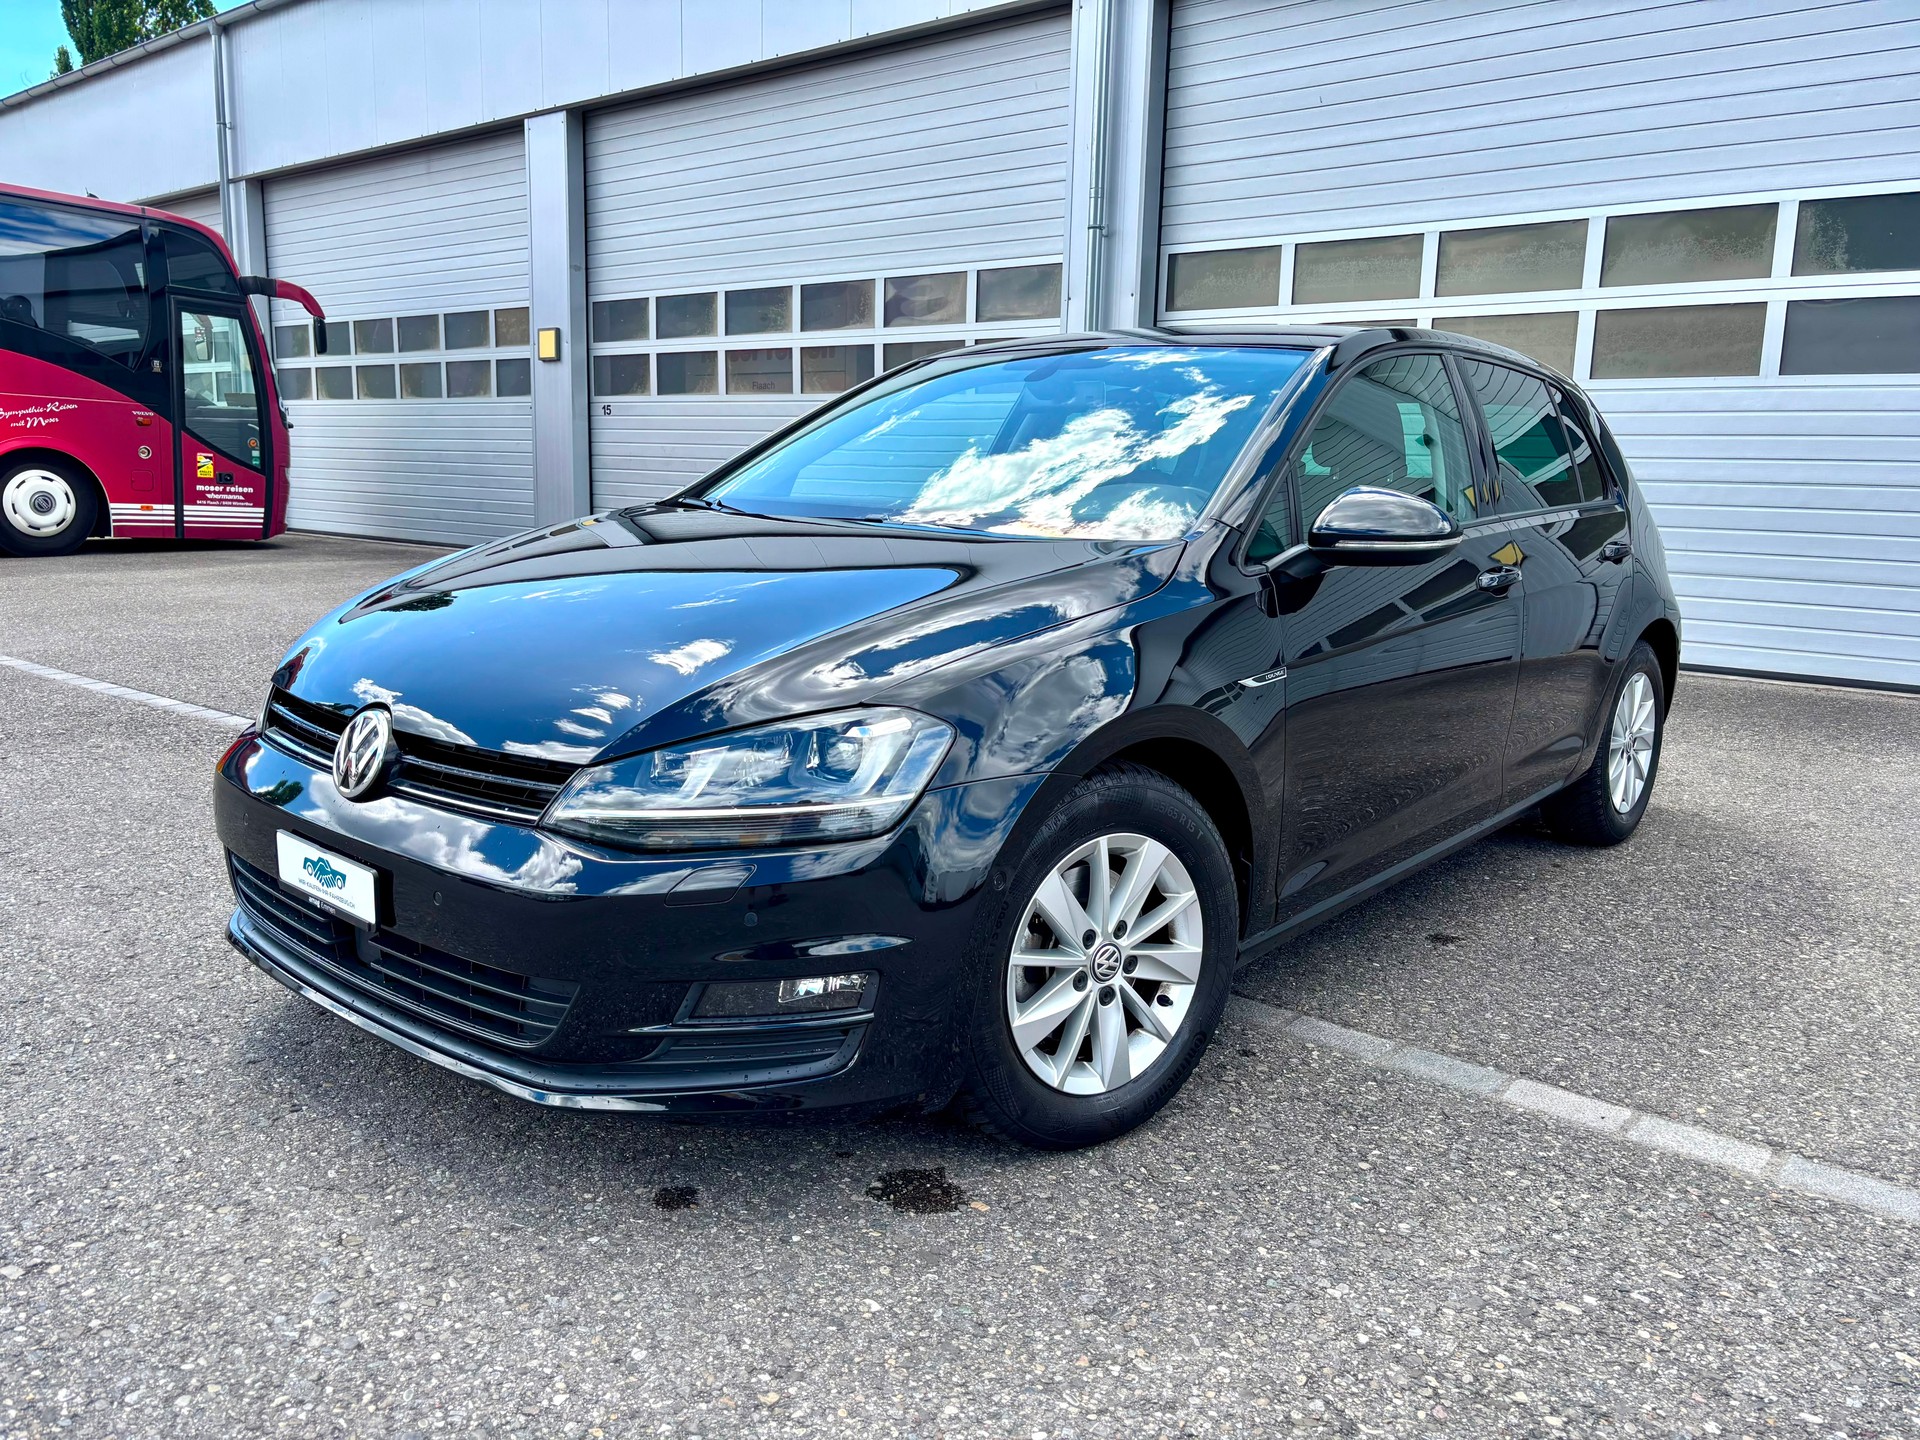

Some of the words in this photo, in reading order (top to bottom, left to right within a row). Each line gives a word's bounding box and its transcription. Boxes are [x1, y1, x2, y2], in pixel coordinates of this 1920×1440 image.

[752, 381, 775, 391] Flaach
[602, 405, 612, 416] 15
[26, 416, 60, 429] Moser
[226, 485, 254, 493] reisen
